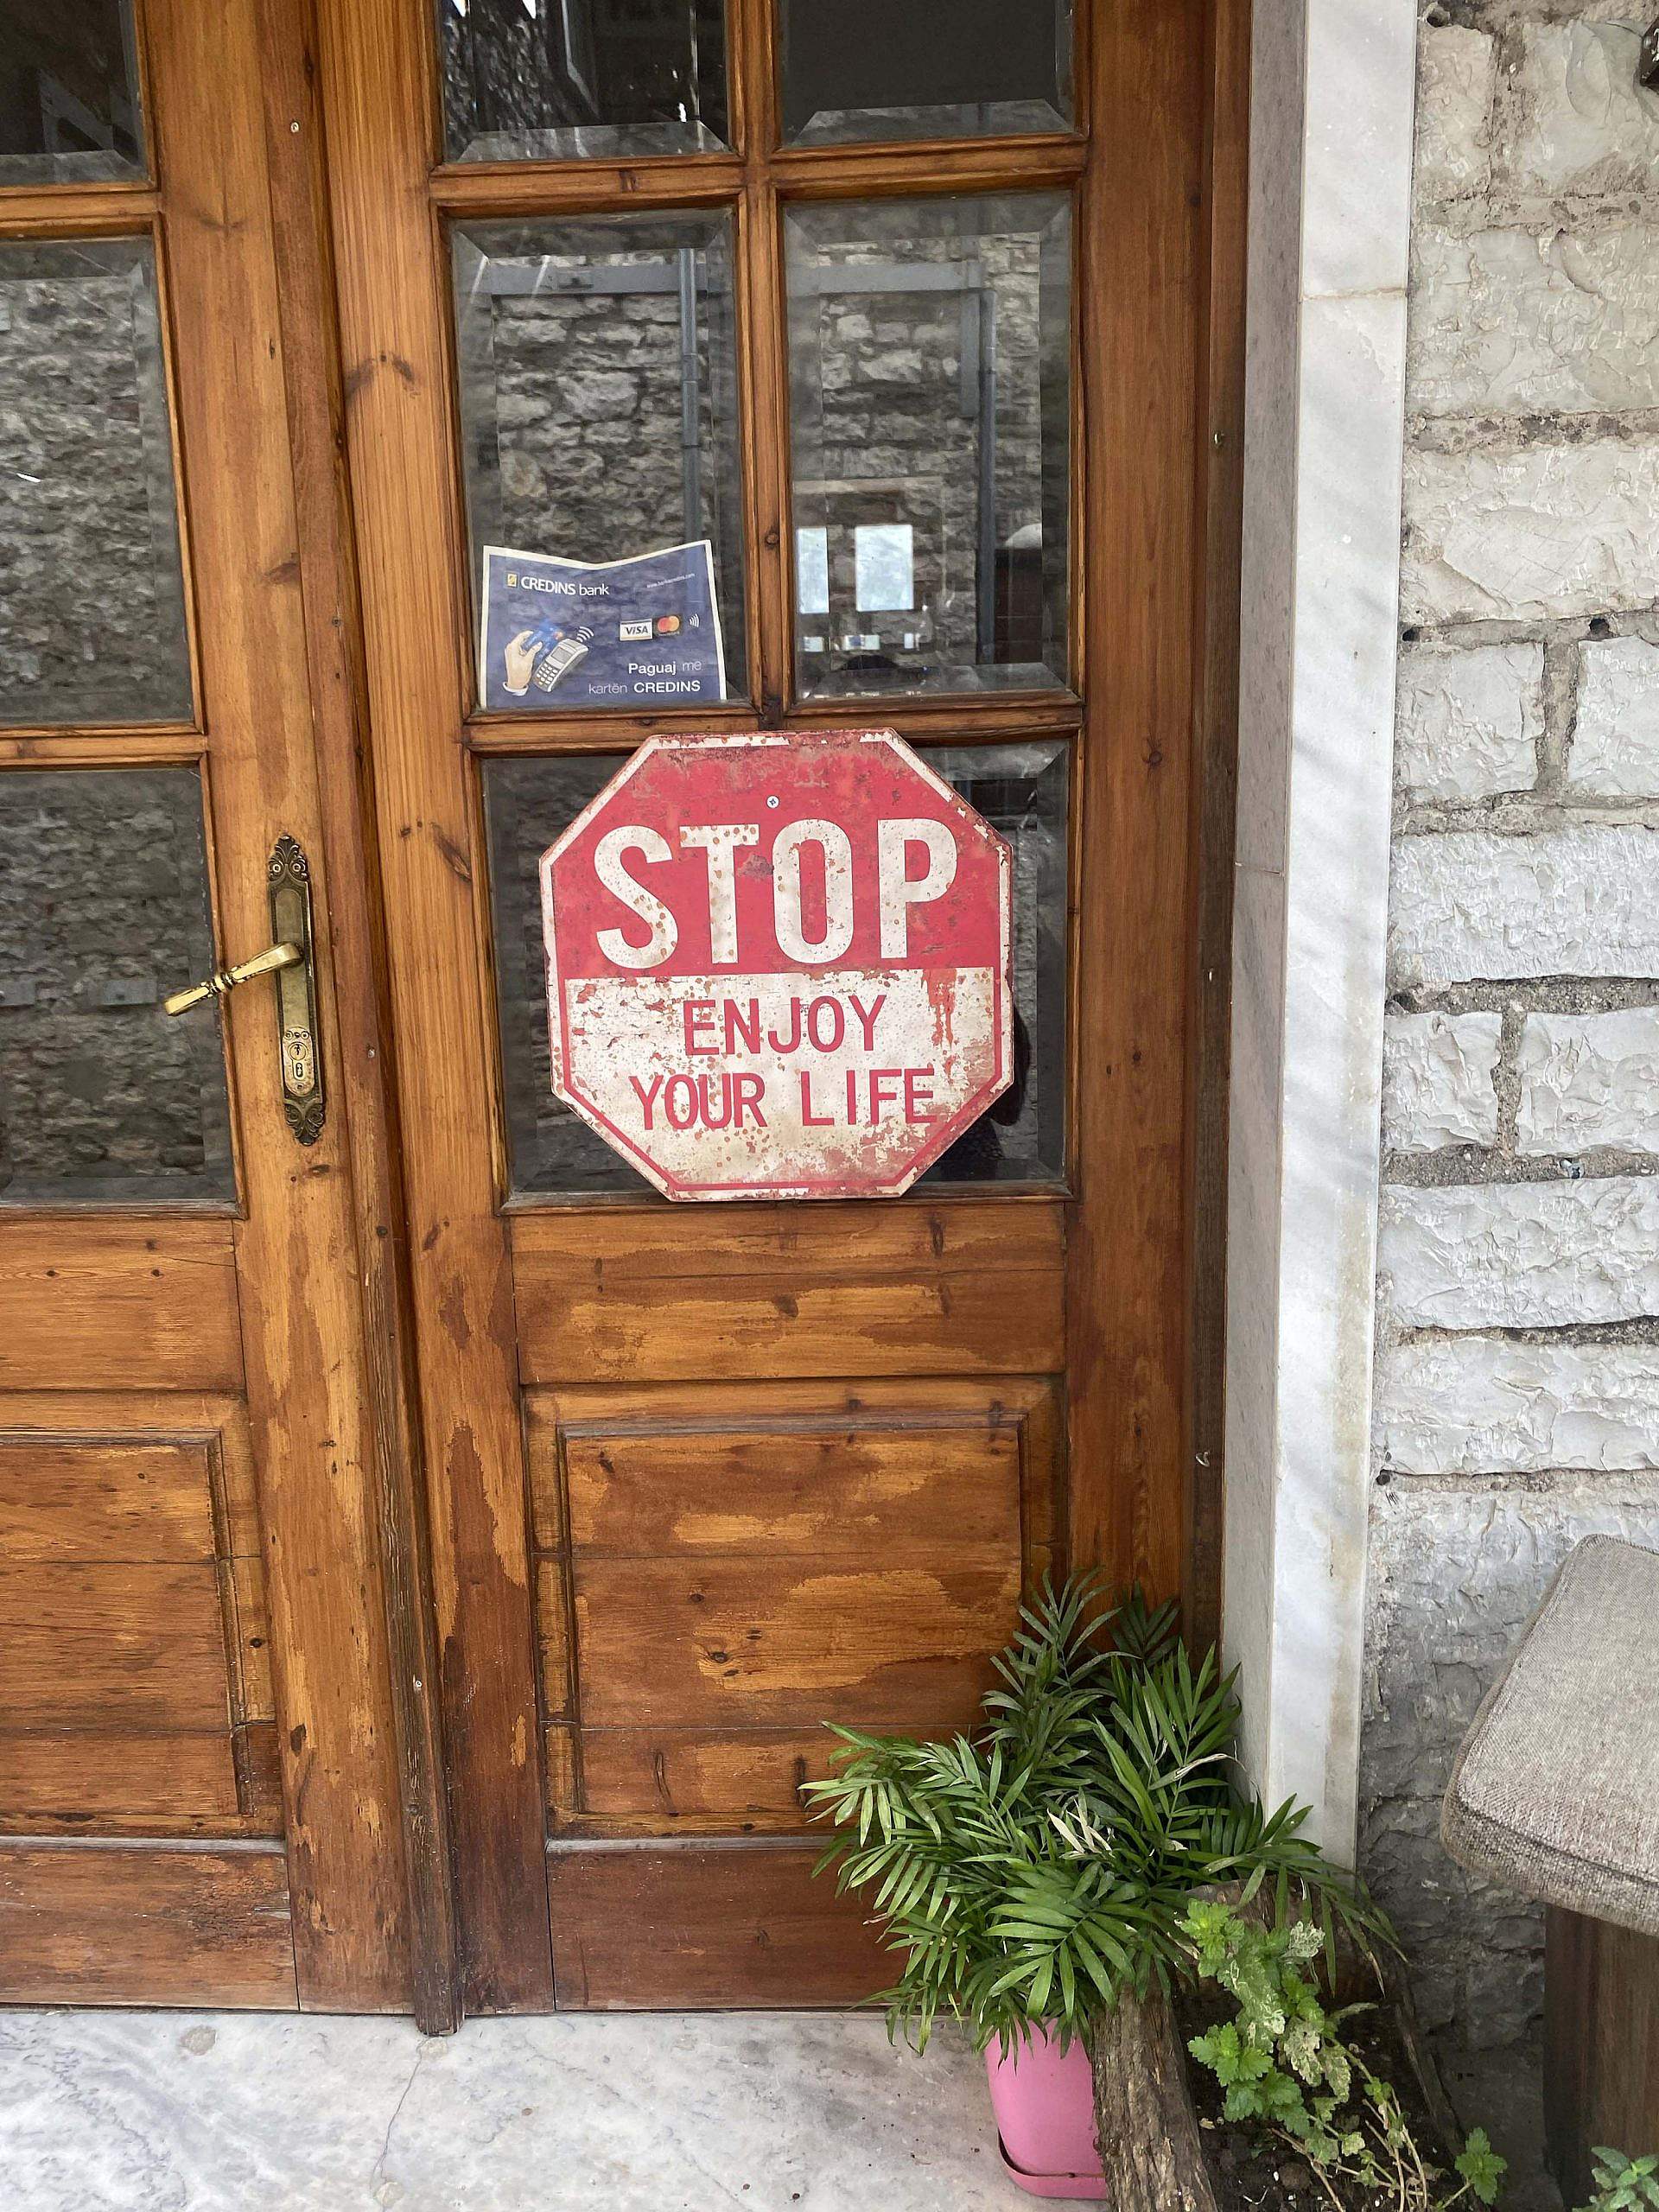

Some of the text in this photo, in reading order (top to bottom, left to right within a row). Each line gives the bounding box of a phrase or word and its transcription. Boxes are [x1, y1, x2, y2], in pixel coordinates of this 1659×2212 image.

[521, 576, 609, 595] CREDINS bank
[588, 680, 701, 694] kartën CREDINS
[628, 661, 677, 676] Paguaj
[594, 817, 957, 969] STOP
[683, 995, 887, 1056] ENJOY
[629, 1068, 938, 1130] YOUR LIFE
